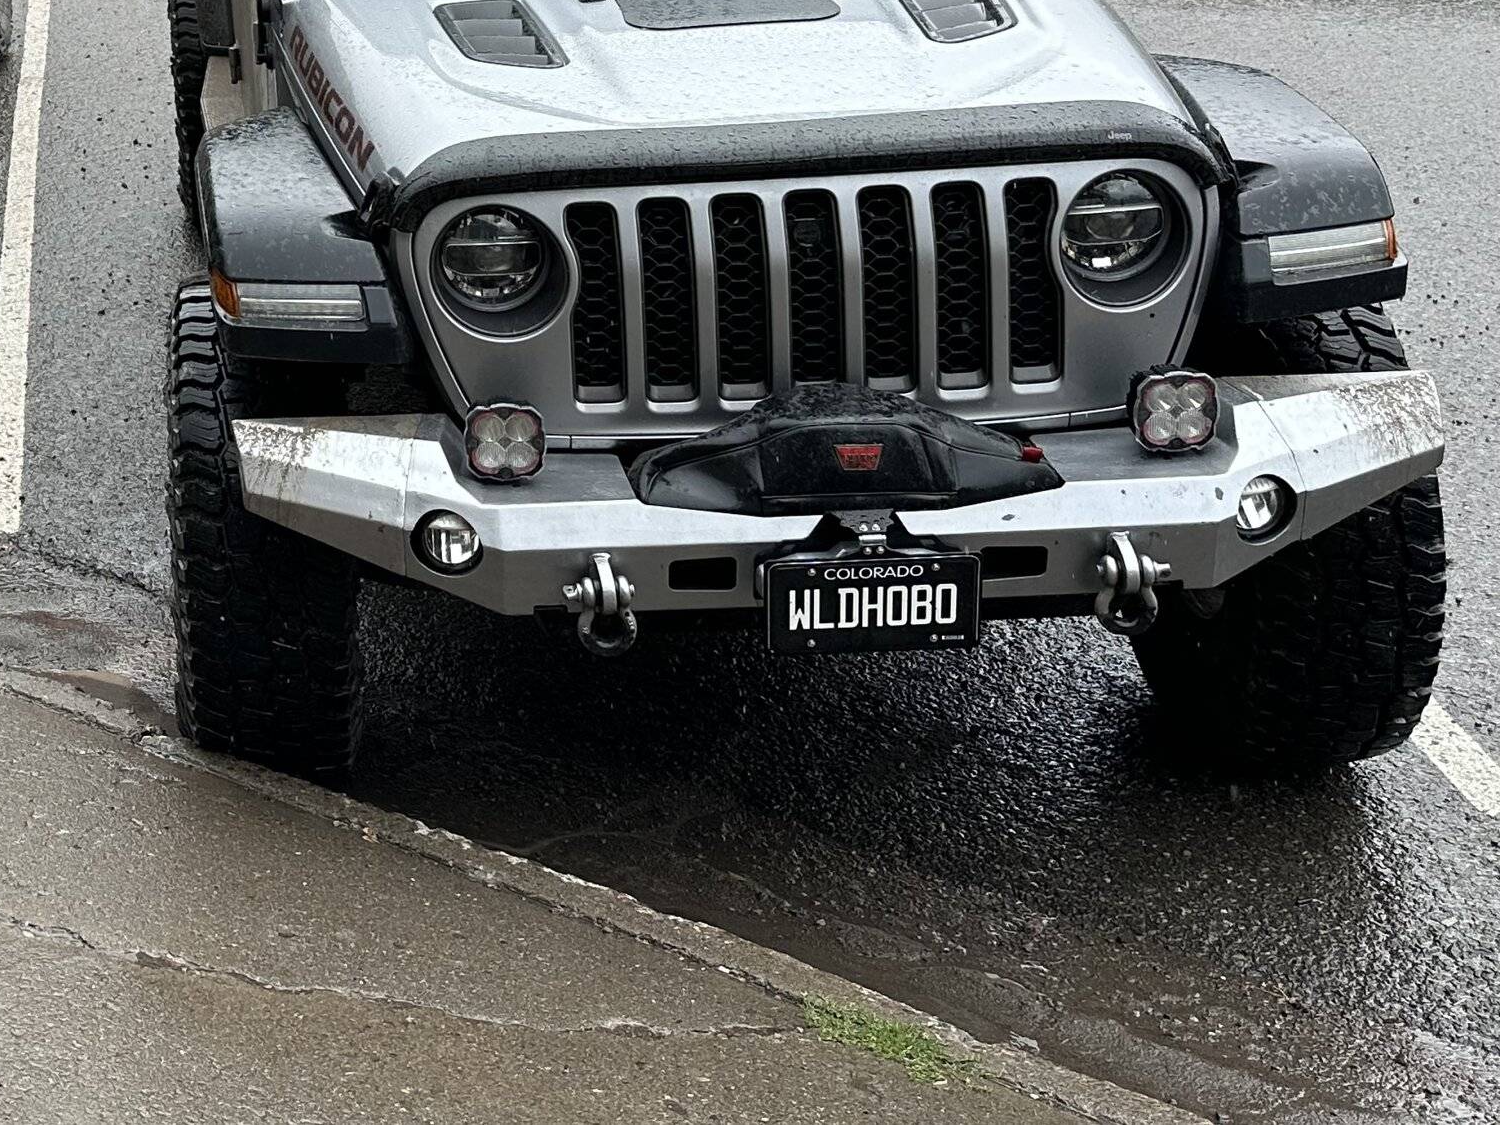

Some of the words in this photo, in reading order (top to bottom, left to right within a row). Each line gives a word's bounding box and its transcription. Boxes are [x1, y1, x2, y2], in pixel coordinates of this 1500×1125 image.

[289, 25, 376, 172] RUBICON
[1107, 130, 1132, 141] Jeep
[824, 565, 924, 581] COLORADO
[789, 583, 958, 631] WLDHOBO
